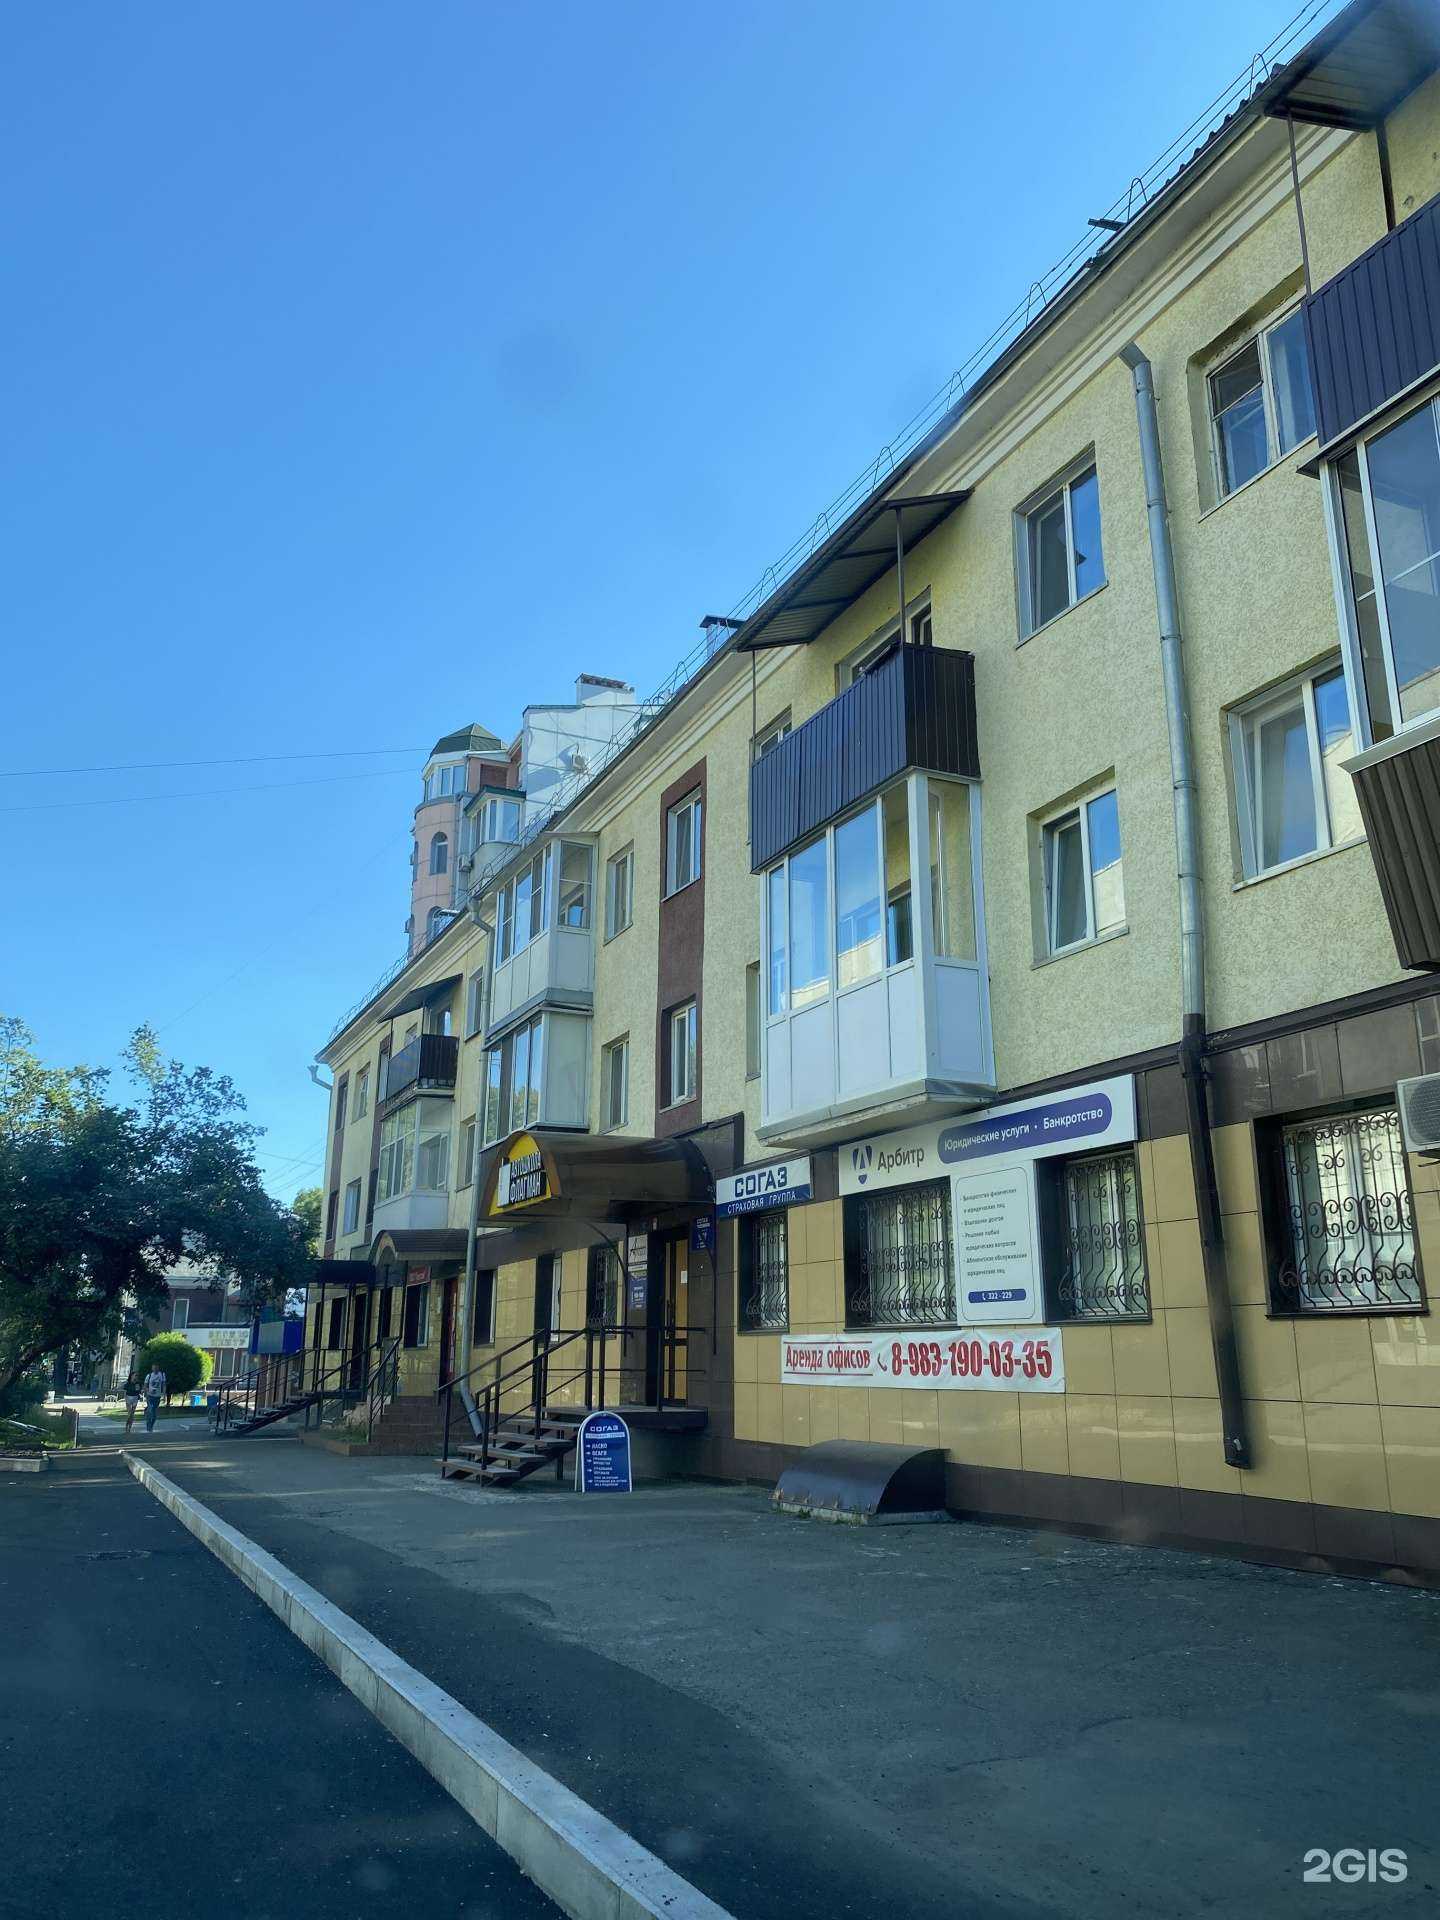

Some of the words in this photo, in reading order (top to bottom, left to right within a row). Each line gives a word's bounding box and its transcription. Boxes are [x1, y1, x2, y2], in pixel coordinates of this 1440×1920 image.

[944, 1130, 1000, 1152] Юридические
[1000, 1124, 1030, 1142] услуги
[1043, 1107, 1103, 1130] Банкротство
[877, 1147, 925, 1174] Арбитр
[510, 1172, 541, 1204] ФЛАГМАН
[734, 1166, 788, 1198] СОГАЗ
[727, 1197, 764, 1215] СТРАХОВАЯ
[769, 1190, 796, 1206] ГРУППА
[785, 1345, 823, 1371] Аренда
[827, 1345, 871, 1372] офисов
[891, 1340, 1053, 1379] 8-983-190-03-35
[590, 1424, 619, 1432] СОГАЗ
